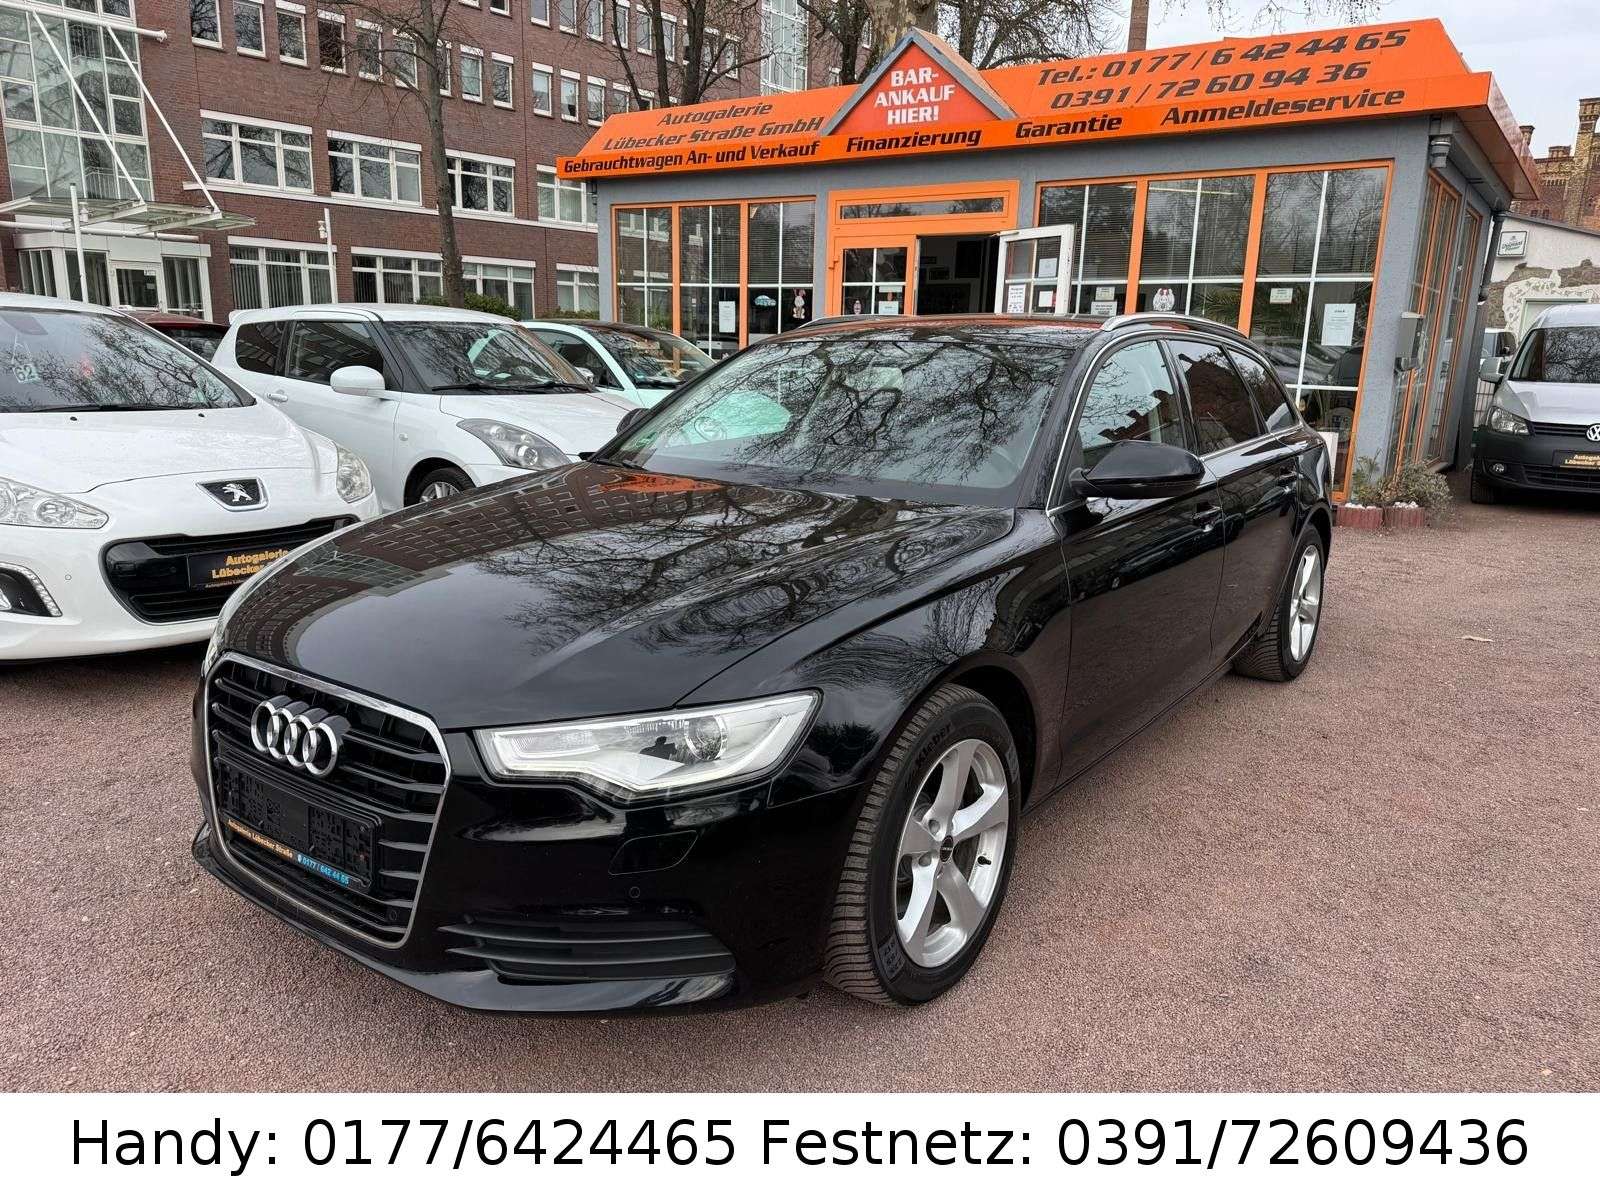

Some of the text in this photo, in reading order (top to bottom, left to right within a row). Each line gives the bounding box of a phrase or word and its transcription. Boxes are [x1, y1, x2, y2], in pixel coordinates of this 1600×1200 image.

[1038, 29, 1410, 86] Tel.: 0177 / 6 42 44 65
[890, 66, 939, 87] BAR-
[1050, 61, 1371, 109] 0391 / 72 60 94 36
[873, 84, 956, 108] ANKAUF
[1160, 88, 1405, 126] Anmeldeservice
[657, 102, 773, 127] Autogalerie
[886, 104, 939, 126] HIER!
[1014, 114, 1123, 139] Garantie
[602, 116, 825, 151] Lübecker Straße GmbH
[846, 128, 982, 153] Finanzierung
[564, 140, 821, 173] Gebrauchtwagen An- und Verkauf
